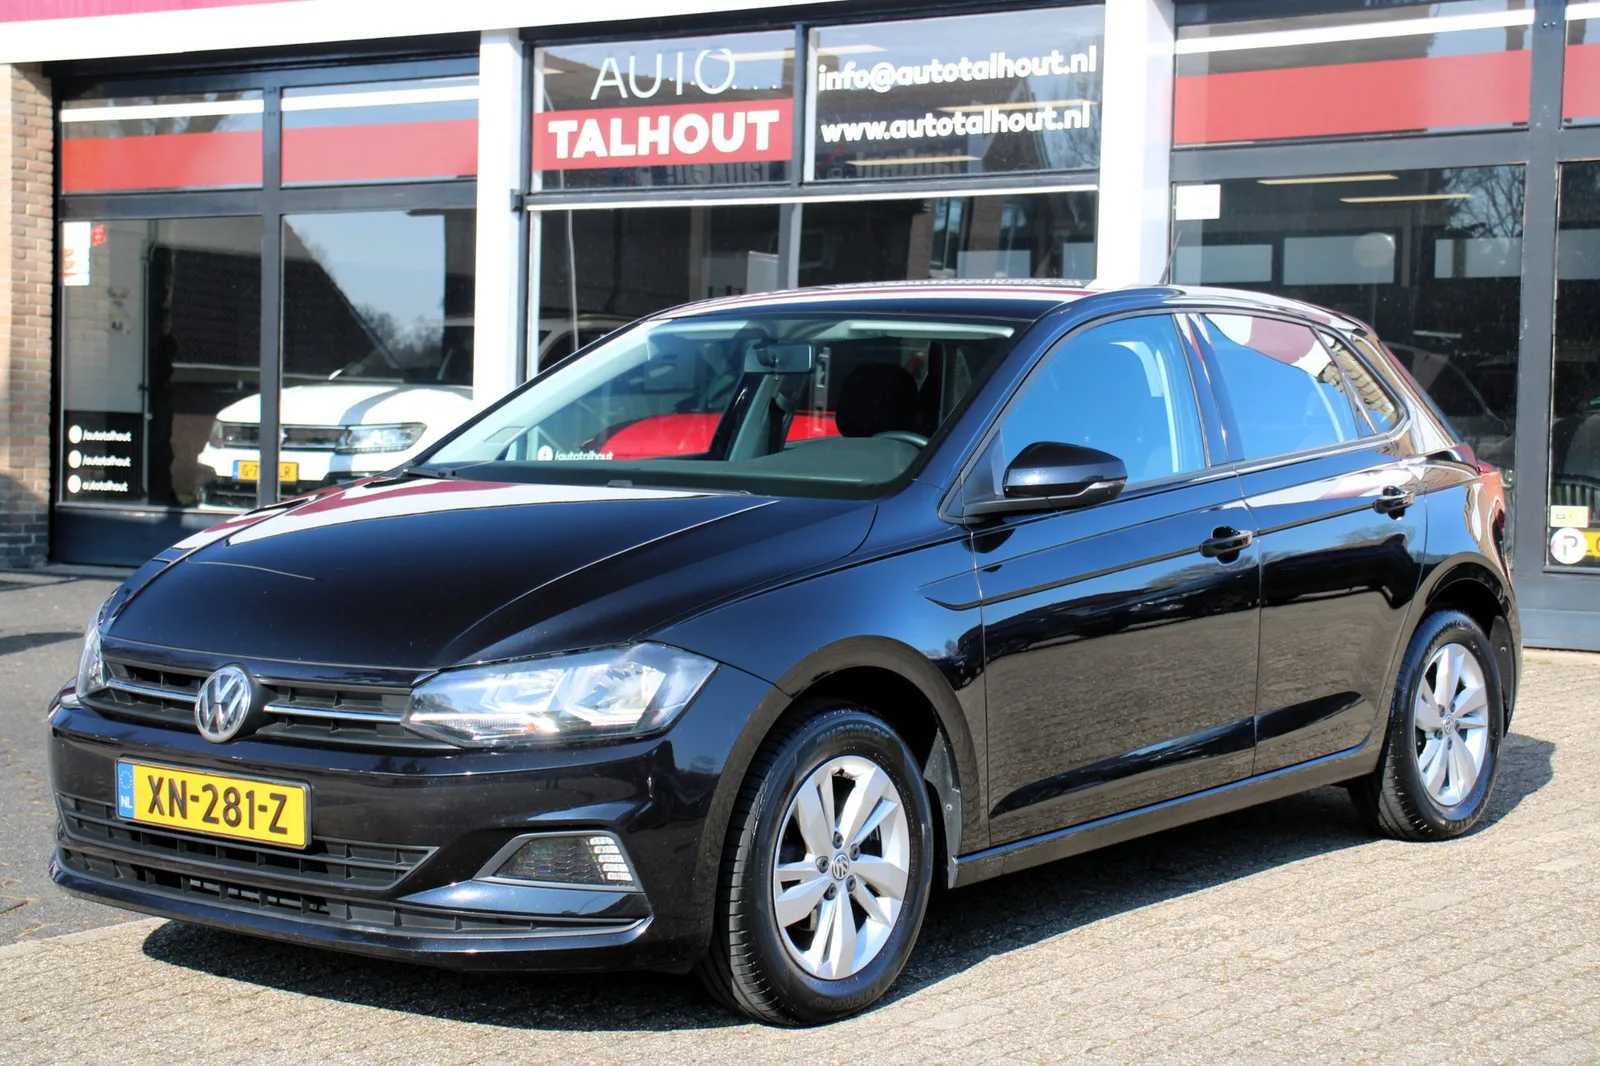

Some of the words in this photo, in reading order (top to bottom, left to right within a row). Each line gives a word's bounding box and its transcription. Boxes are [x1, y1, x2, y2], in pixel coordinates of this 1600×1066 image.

[818, 45, 1097, 93] info@autotalhout.nl
[548, 110, 780, 159] TALHOUT
[820, 101, 1091, 143] www.autotalhout.nl
[120, 794, 133, 809] NL
[147, 774, 289, 836] XN-281-Z
